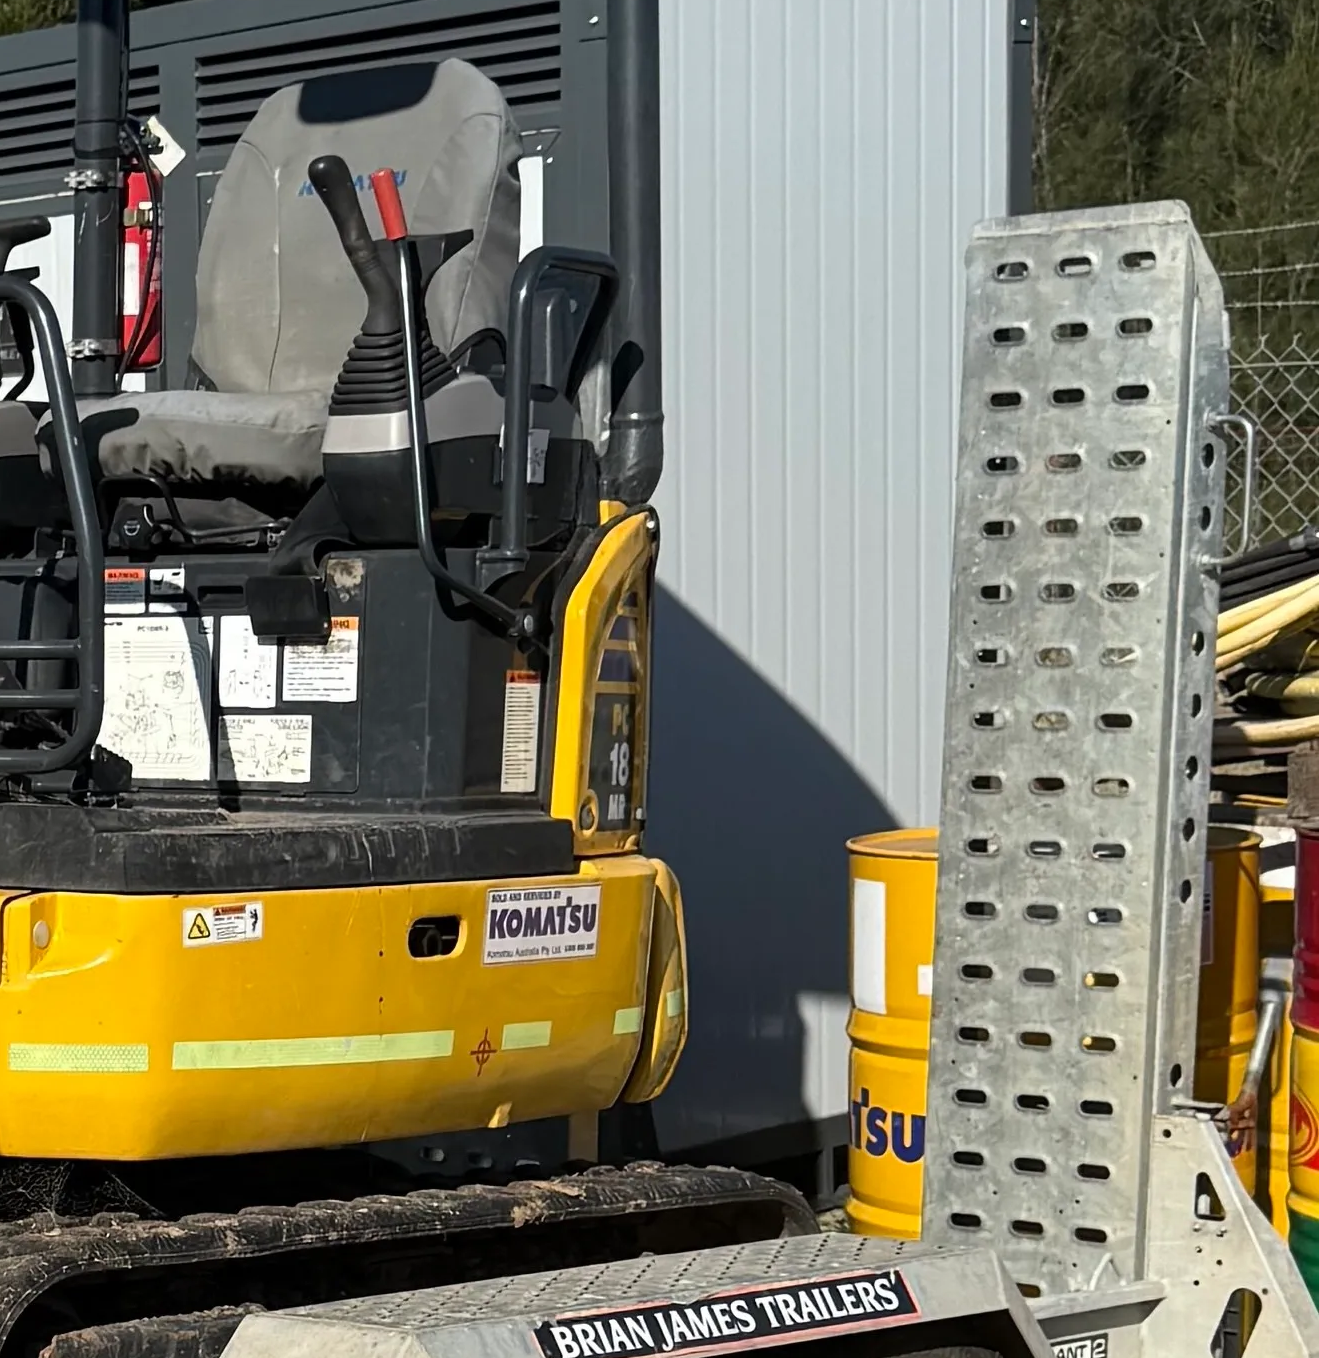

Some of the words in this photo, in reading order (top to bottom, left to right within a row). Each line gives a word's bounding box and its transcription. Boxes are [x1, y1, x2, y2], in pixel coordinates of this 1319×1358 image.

[609, 742, 630, 787] 18
[607, 793, 626, 821] MR
[489, 896, 597, 940] KOMATSU
[653, 1299, 758, 1353] JAMES
[1092, 1338, 1106, 1358] 2
